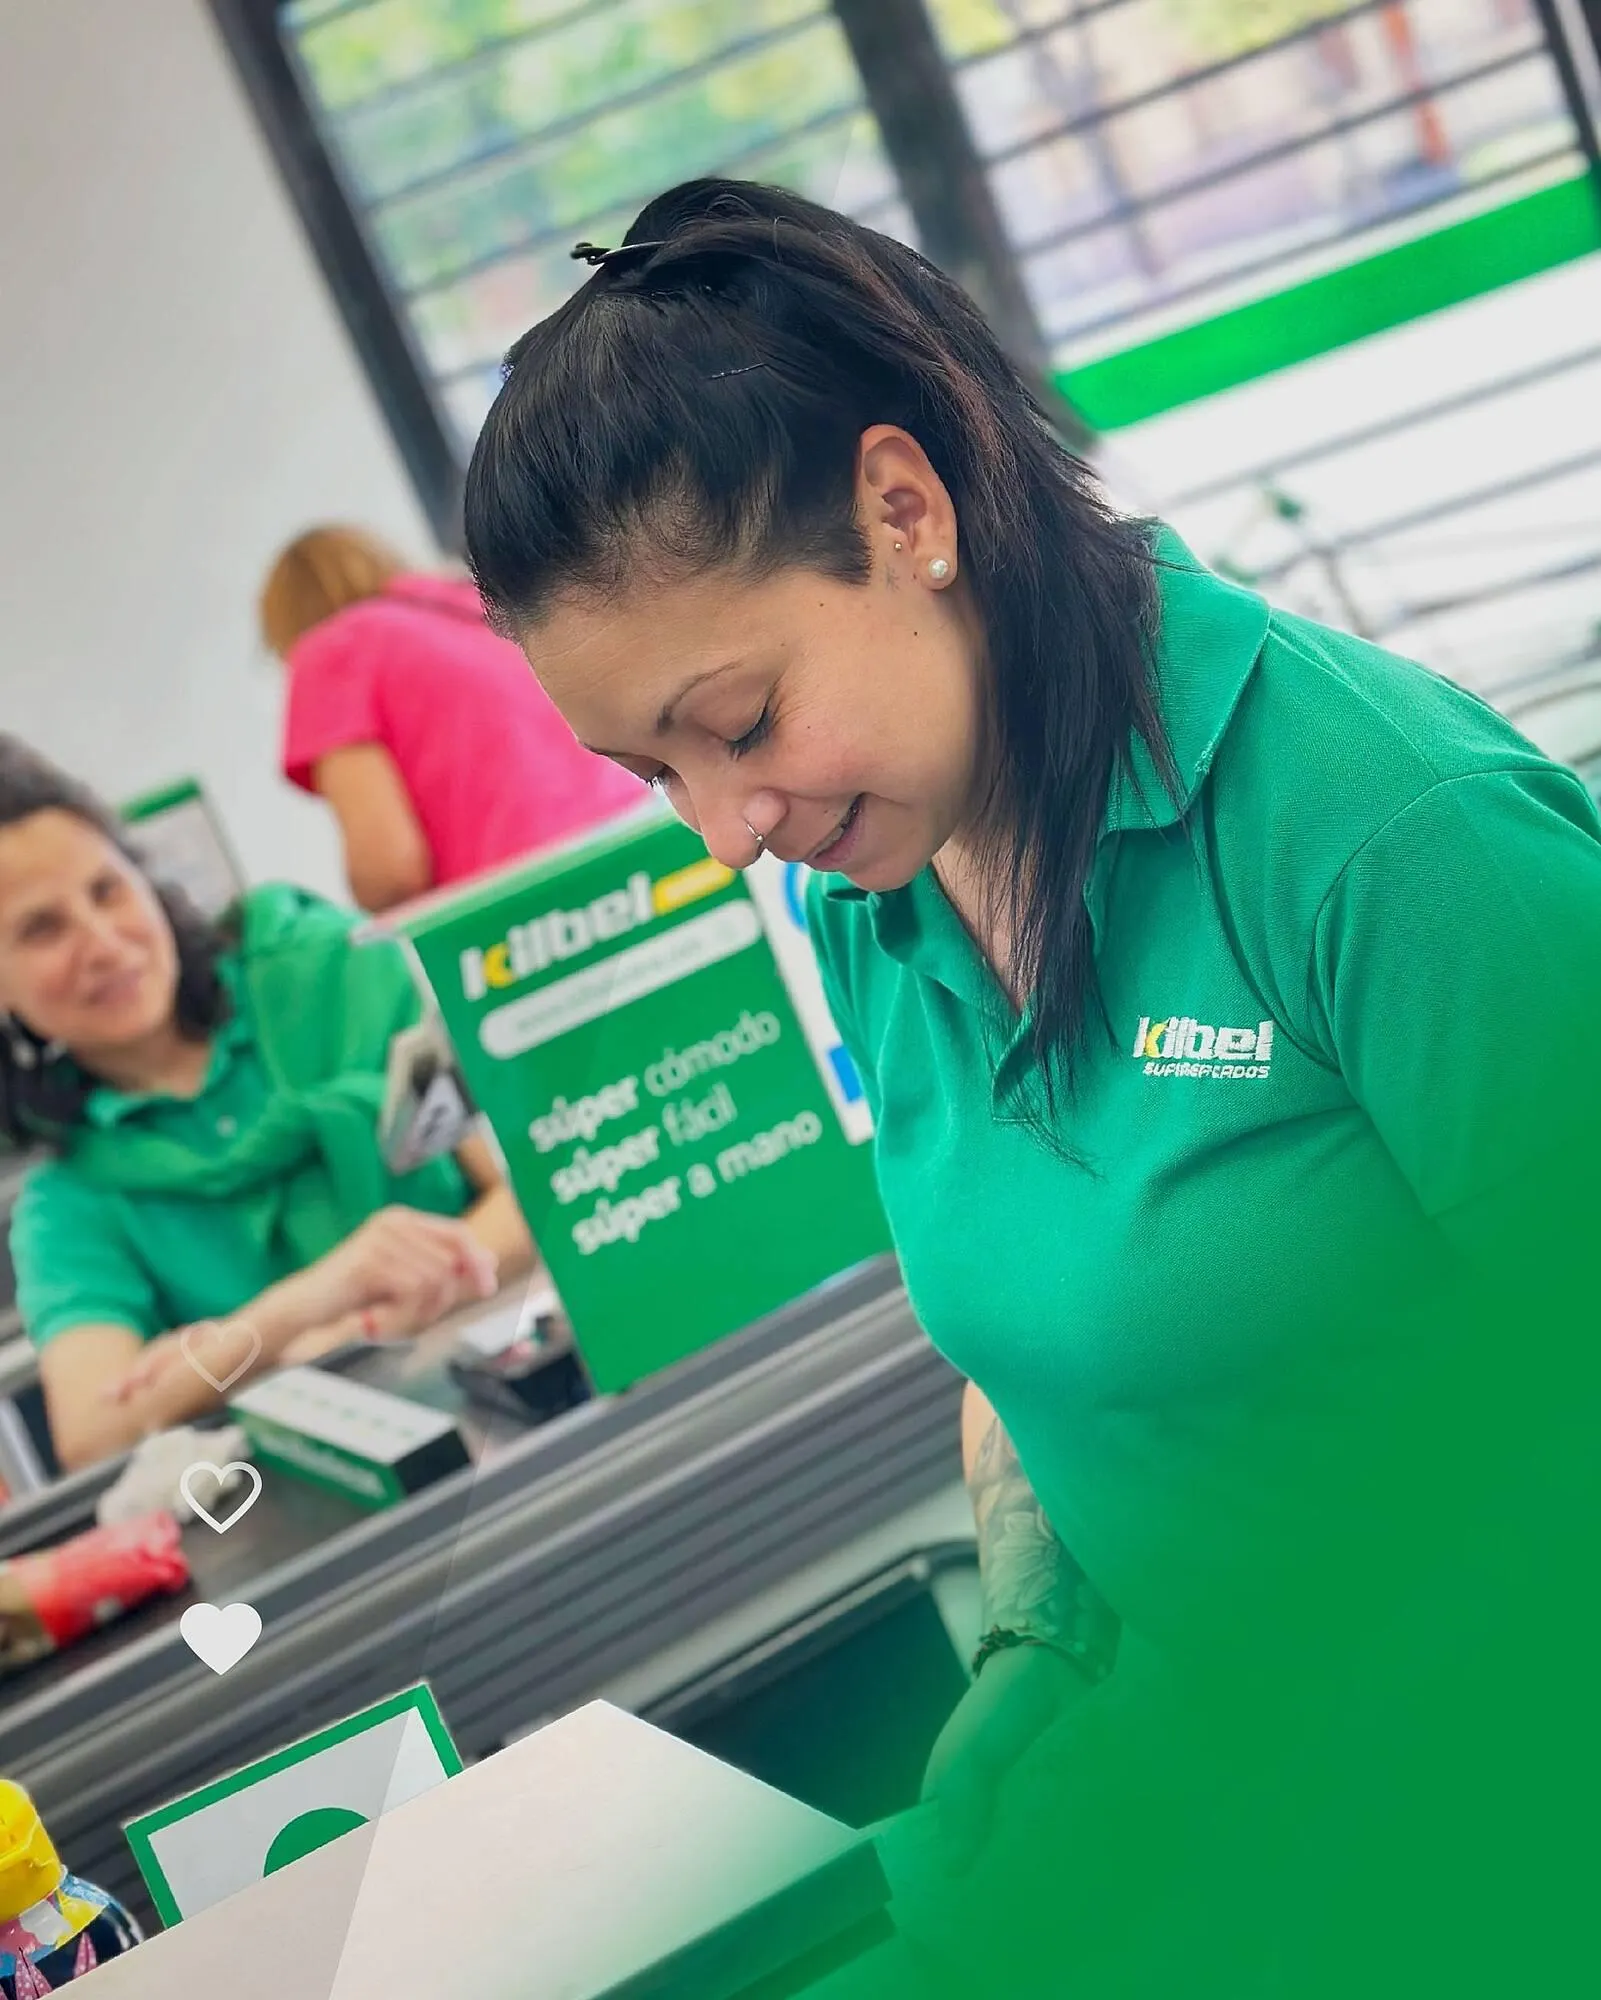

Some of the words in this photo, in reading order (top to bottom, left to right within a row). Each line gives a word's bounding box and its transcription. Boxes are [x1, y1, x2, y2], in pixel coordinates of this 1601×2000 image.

[459, 870, 654, 1002] kilbel
[529, 1076, 638, 1152] súper
[645, 1011, 780, 1096] cómodo
[1132, 1016, 1274, 1062] kilbel
[551, 1126, 659, 1203] súper
[662, 1084, 737, 1143] fácil
[572, 1176, 680, 1255] súper
[687, 1164, 716, 1197] a
[716, 1111, 822, 1183] mano
